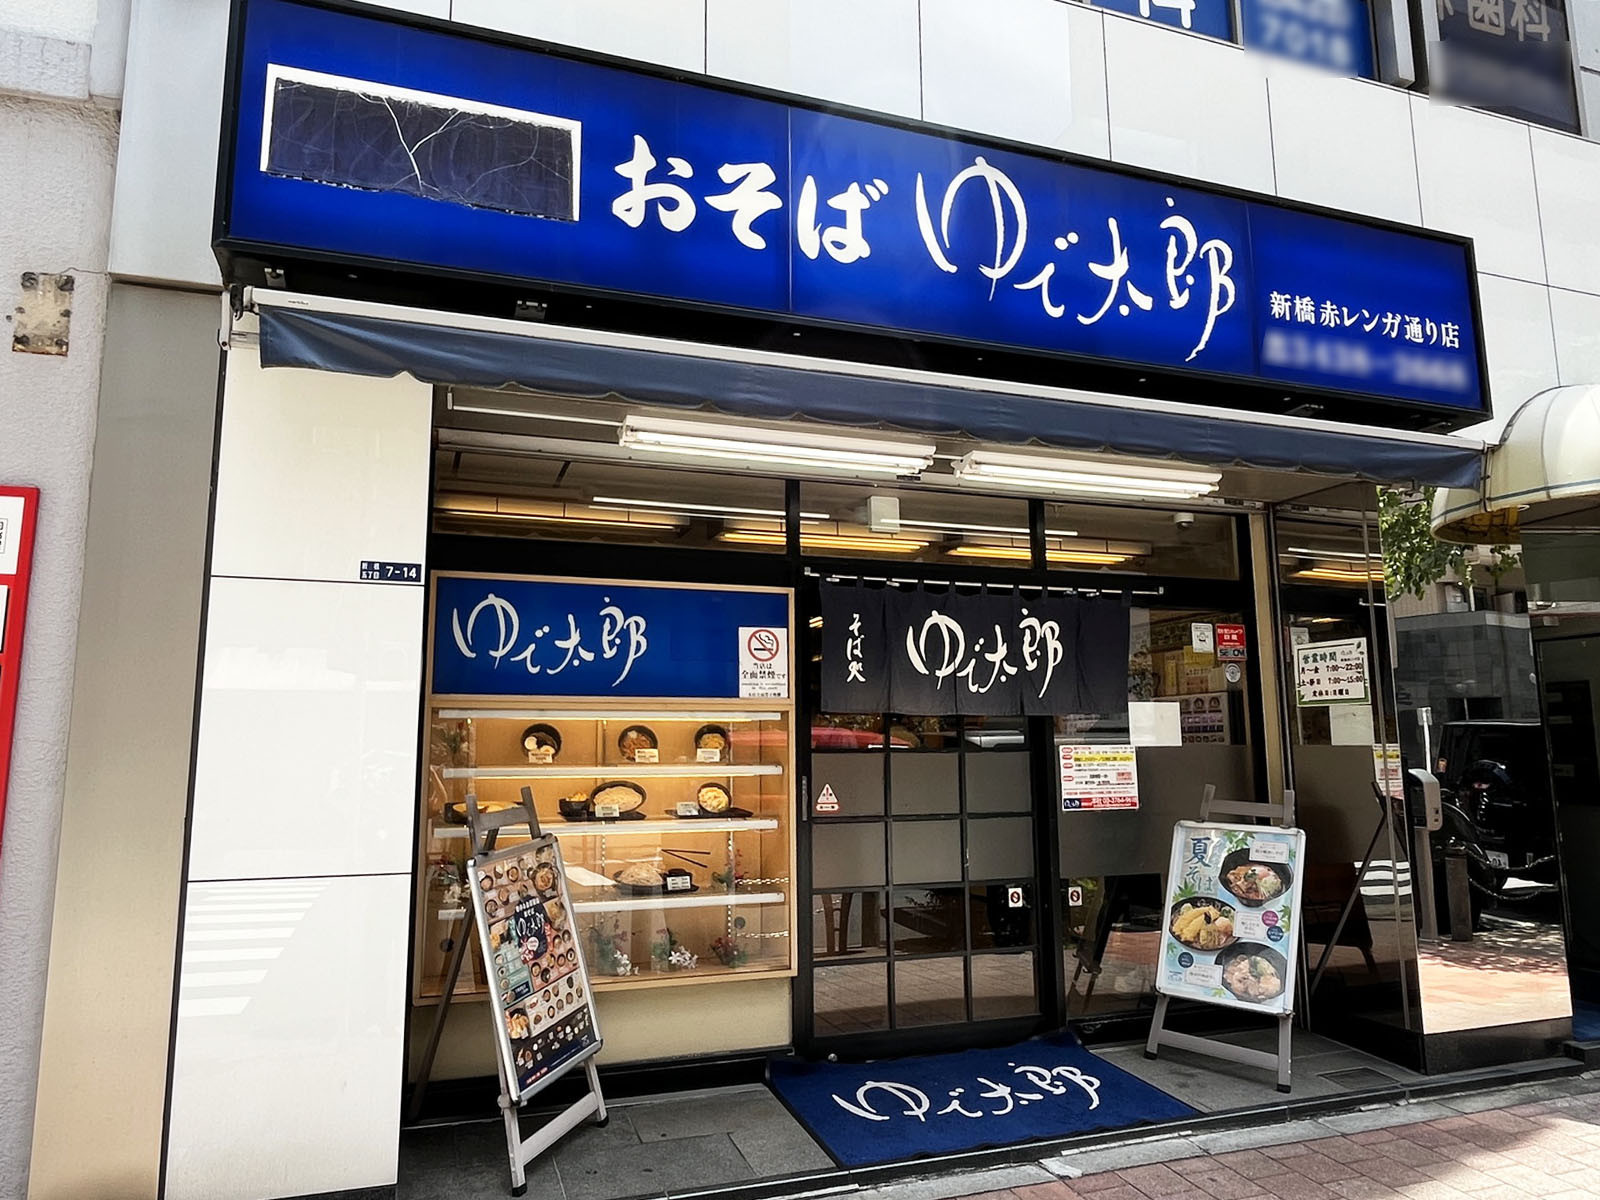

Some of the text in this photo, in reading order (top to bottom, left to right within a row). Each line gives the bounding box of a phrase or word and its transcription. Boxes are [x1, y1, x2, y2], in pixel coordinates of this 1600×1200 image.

[611, 134, 1236, 362] おそば ゆで太郎
[1269, 290, 1460, 348] 新橋赤レンガ通り店
[386, 565, 417, 578] 7-14
[452, 593, 647, 687] ゆで太郎
[906, 608, 1063, 699] ゆで太郎
[831, 1062, 1101, 1122] ゆで太郎
